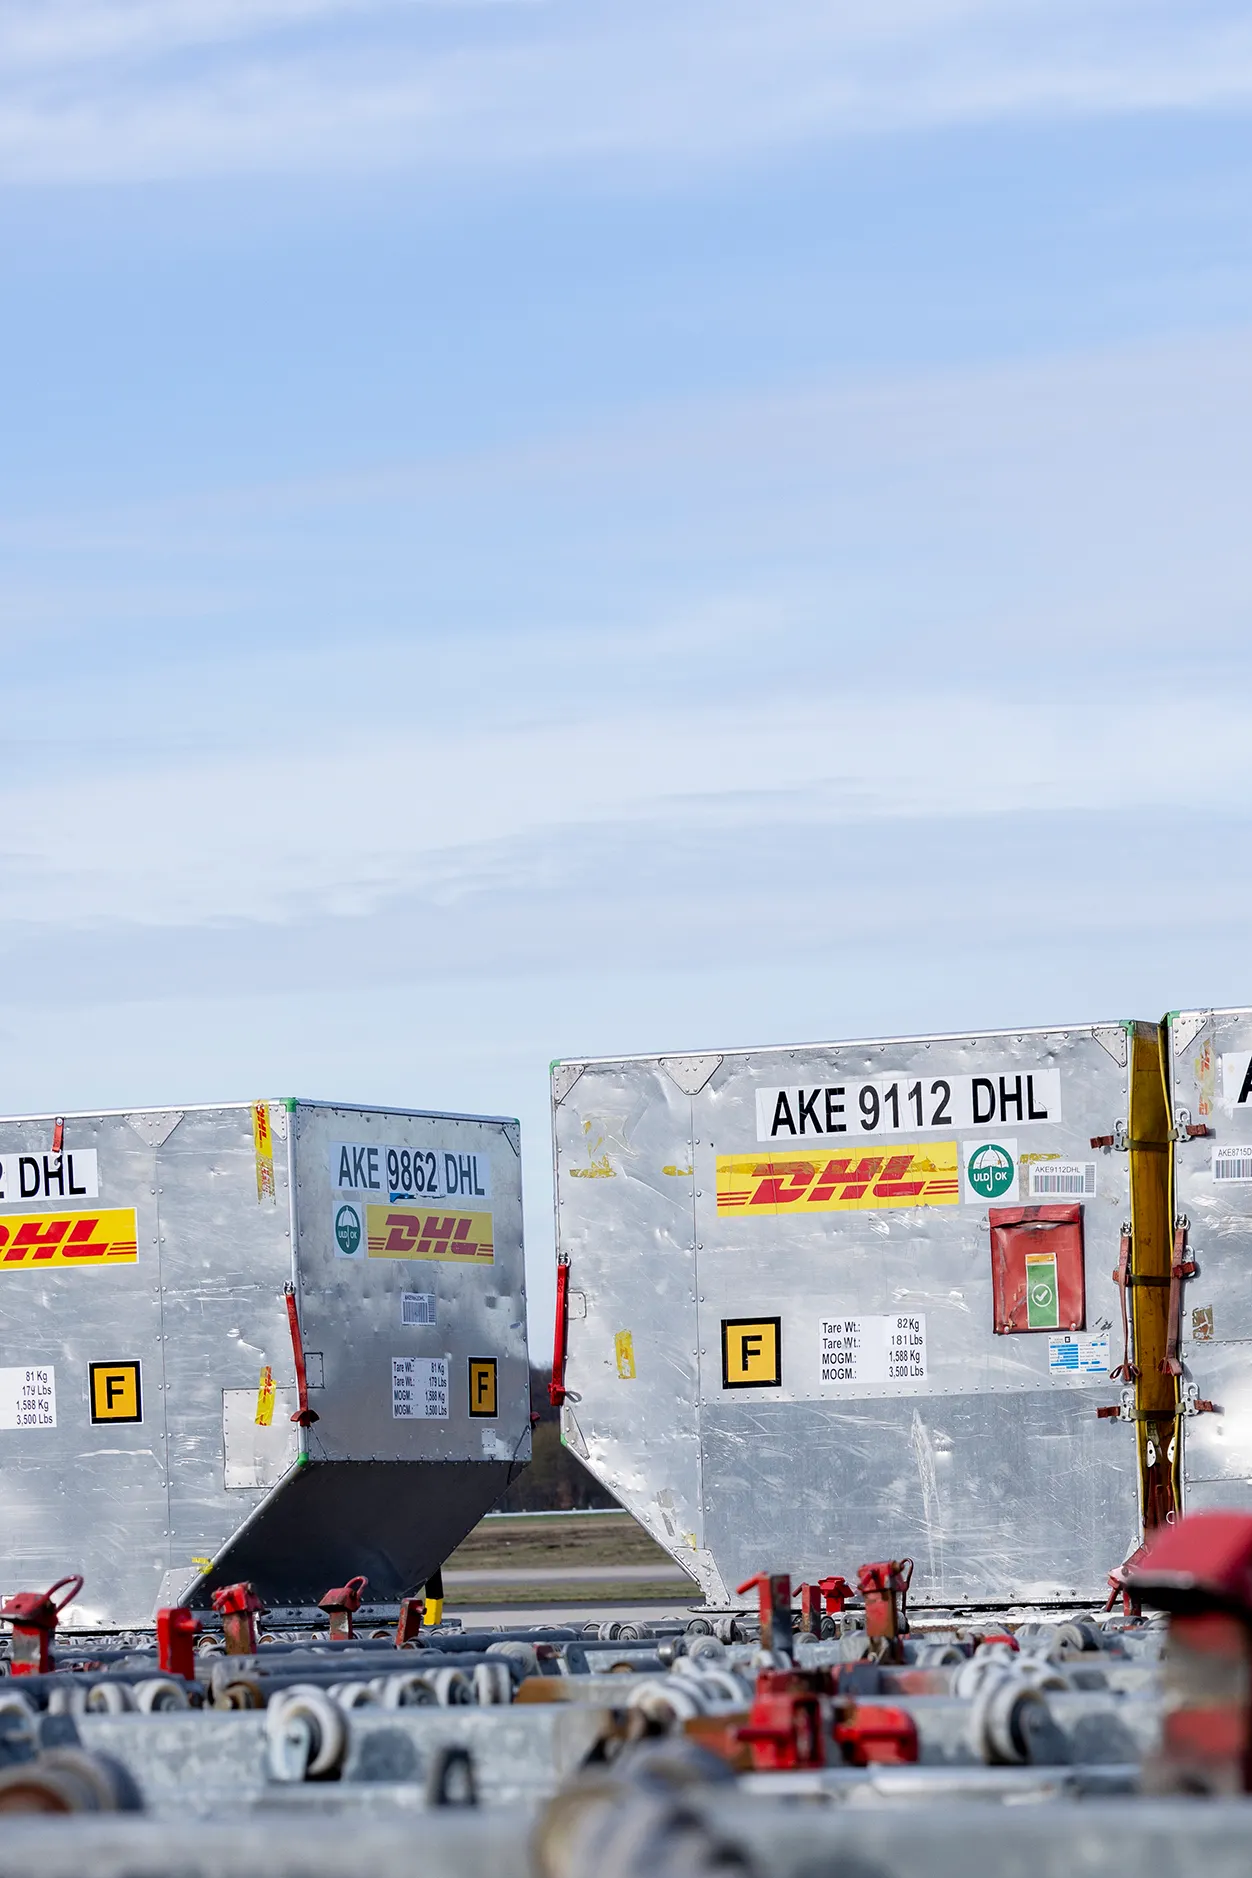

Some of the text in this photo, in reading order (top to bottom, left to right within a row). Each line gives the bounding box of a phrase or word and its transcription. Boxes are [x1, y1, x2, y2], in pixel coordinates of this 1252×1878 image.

[770, 1074, 1048, 1136] AKE 9112 DHL
[19, 1154, 87, 1198] DHL
[338, 1145, 485, 1196] AKE 9862 DHL
[973, 1171, 1008, 1182] ULD OK
[749, 1154, 926, 1205] DHL
[0, 1218, 109, 1262] HL
[338, 1230, 358, 1239] ULD OK
[385, 1214, 479, 1256] DHL
[822, 1318, 920, 1334] Tare Wt.: 82 Kg
[822, 1338, 842, 1349] Tare
[891, 1335, 907, 1345] 181
[909, 1334, 923, 1345] Lbs
[741, 1335, 762, 1371] F
[822, 1350, 920, 1364] MOGM.: 1,588 Kg
[393, 1361, 404, 1372] Tare
[431, 1362, 437, 1373] 81
[438, 1362, 445, 1376] Kg
[822, 1365, 924, 1380] MOGM.: 3,500 Lbs
[25, 1370, 48, 1383] 81 Kg
[393, 1376, 405, 1387] Tare
[429, 1377, 437, 1387] 179
[438, 1377, 447, 1388] Lbs
[22, 1385, 52, 1396] 179 Lbs
[106, 1376, 125, 1409] F
[478, 1372, 489, 1404] F
[438, 1390, 445, 1404] Kg
[16, 1399, 49, 1412] 1,588 Kg
[438, 1405, 447, 1416] Lbs
[16, 1414, 53, 1426] 3,500 Lbs
